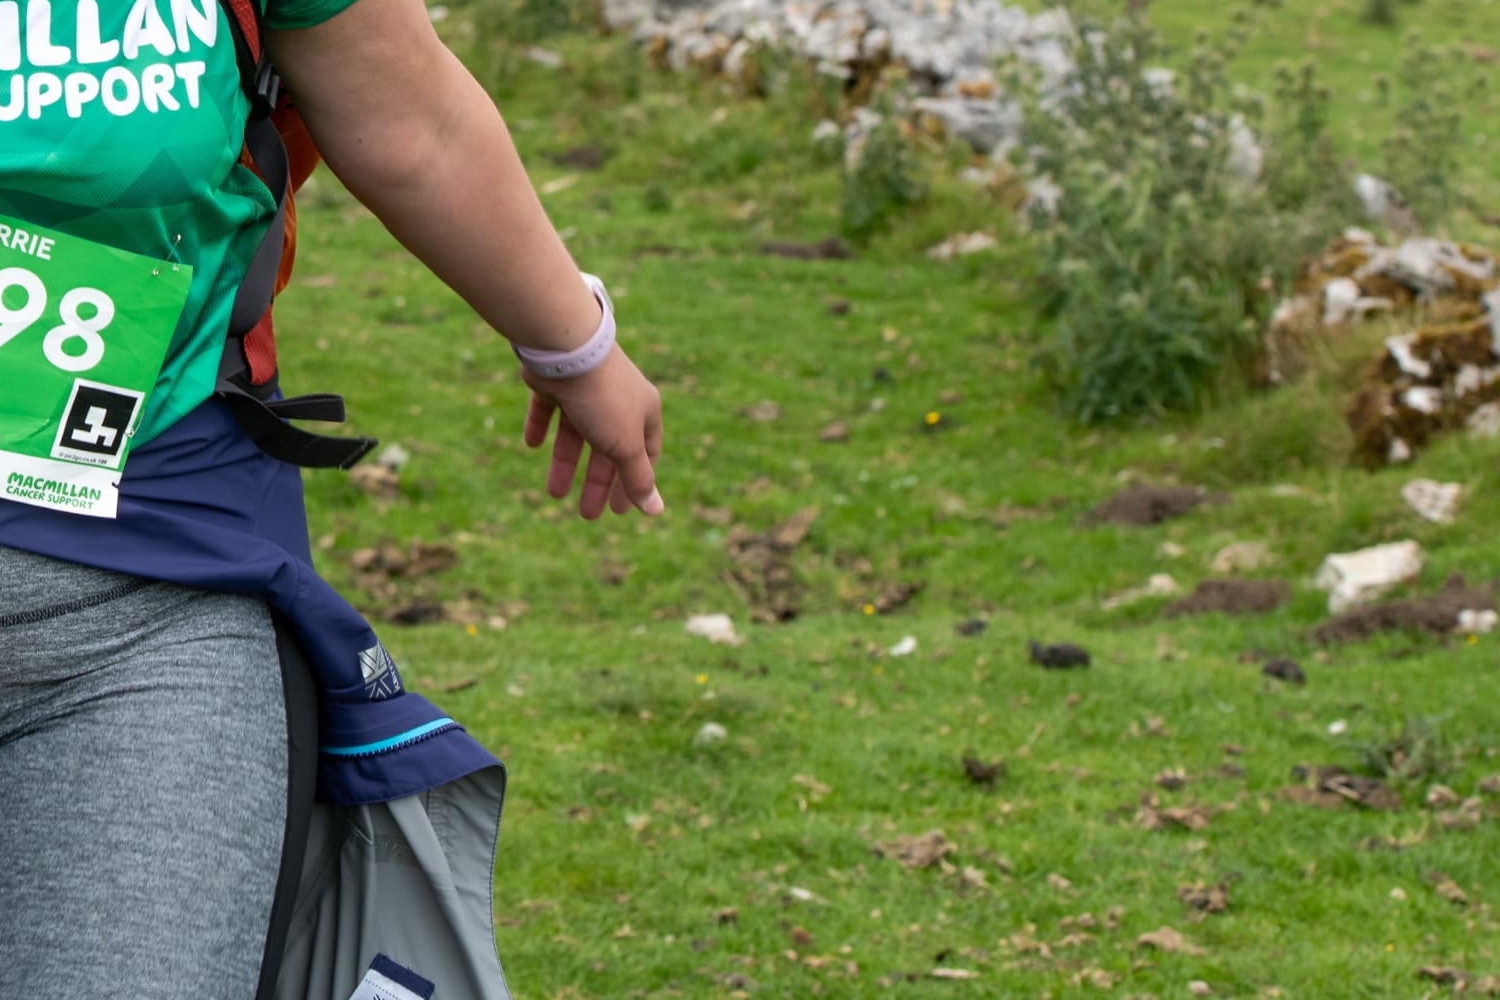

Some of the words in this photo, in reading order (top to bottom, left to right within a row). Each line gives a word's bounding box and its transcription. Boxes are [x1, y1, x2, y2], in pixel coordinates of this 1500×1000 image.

[6, 485, 45, 501] CANCER
[47, 493, 94, 510] SUPPORT
[7, 472, 101, 501] MACMILLAN
